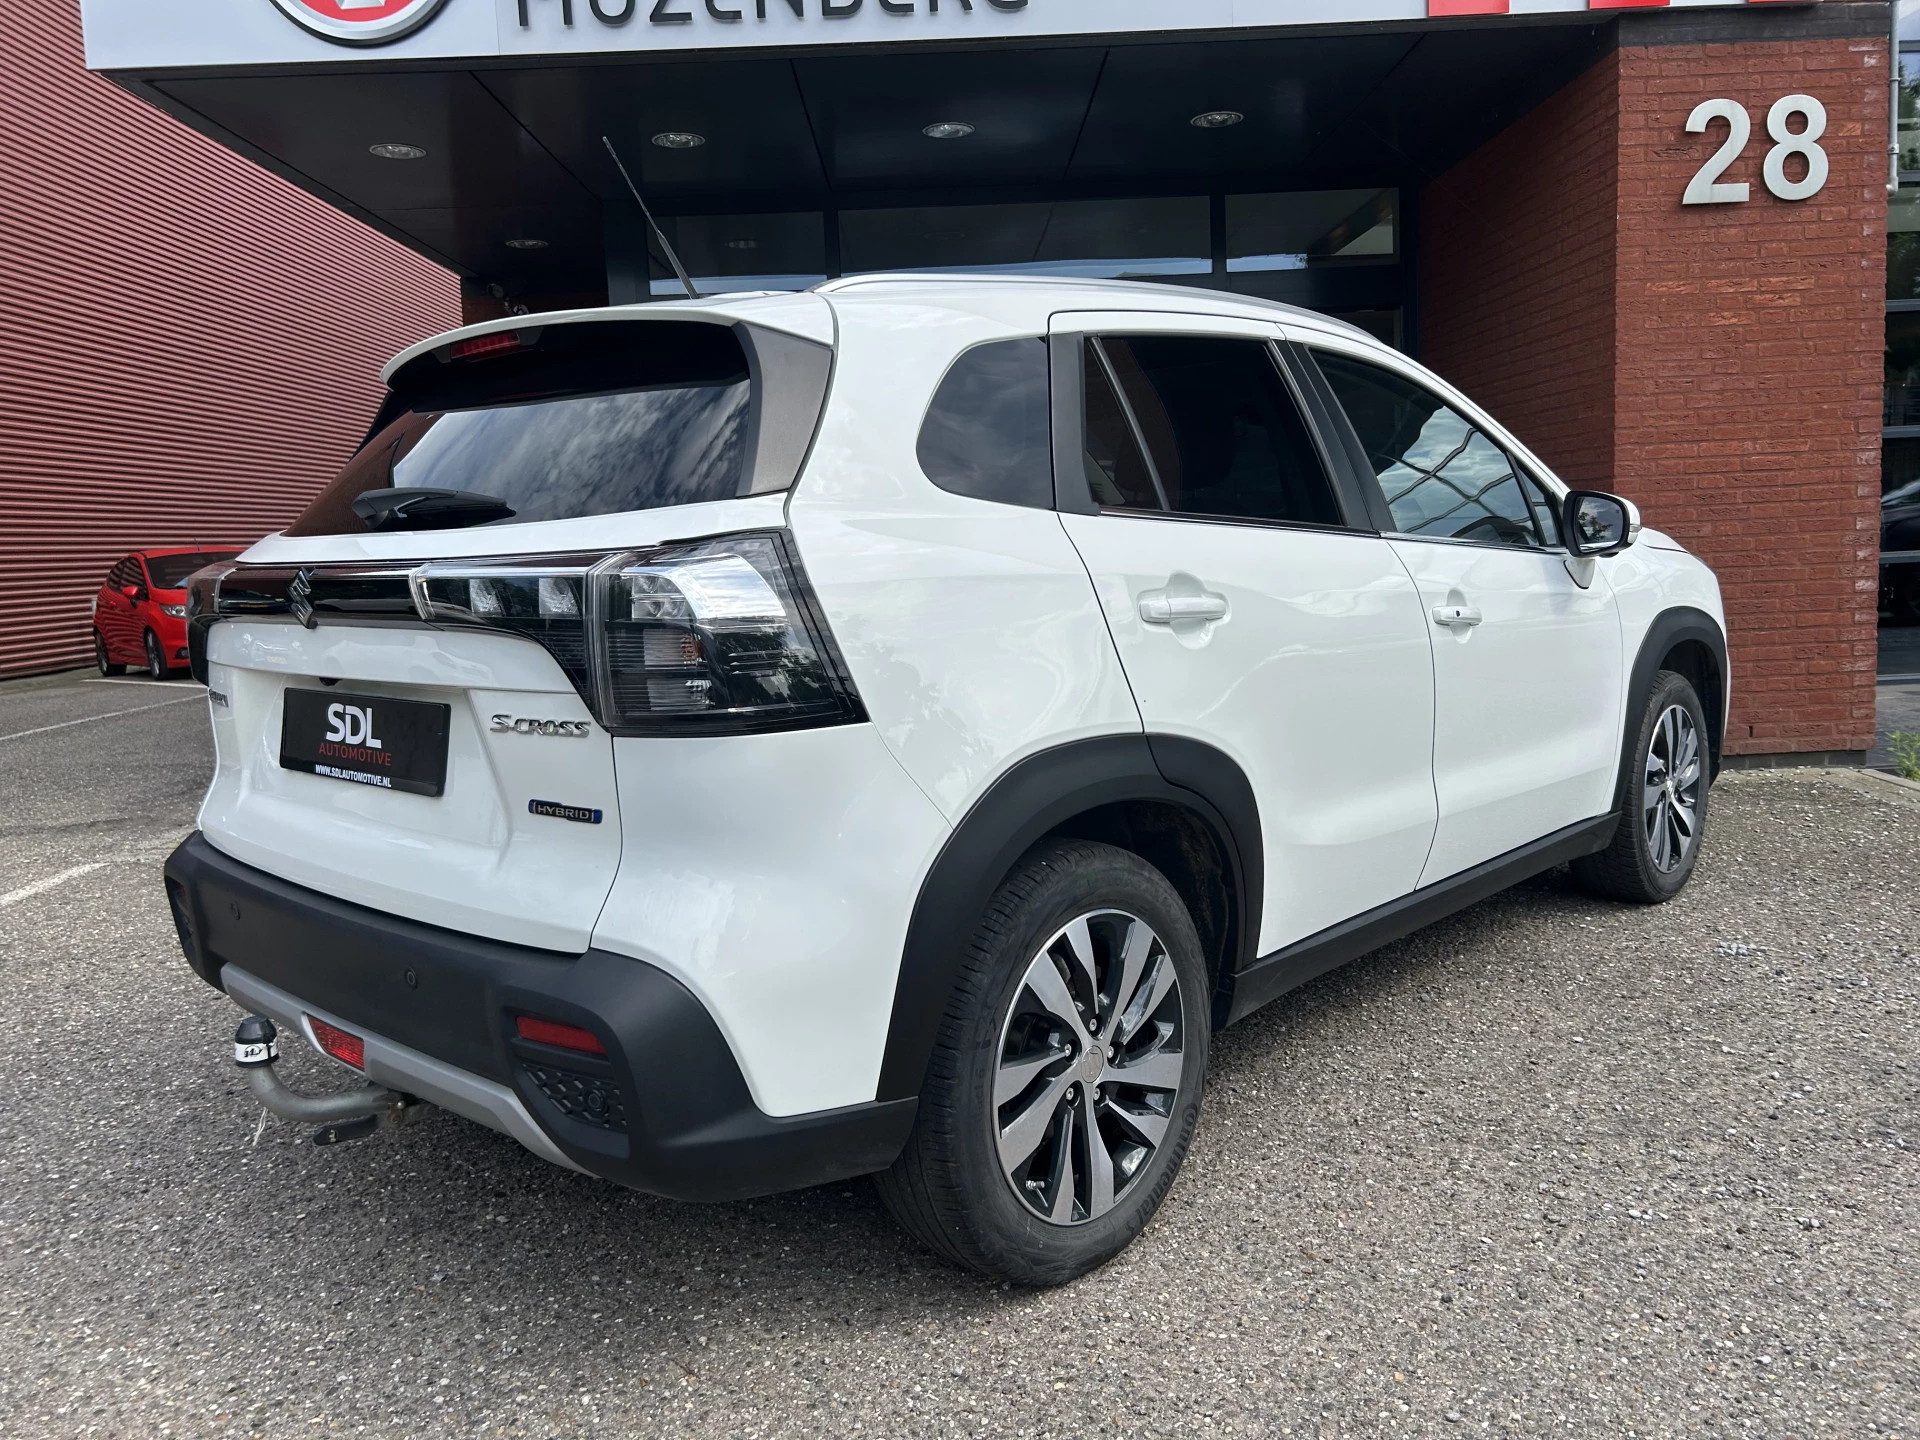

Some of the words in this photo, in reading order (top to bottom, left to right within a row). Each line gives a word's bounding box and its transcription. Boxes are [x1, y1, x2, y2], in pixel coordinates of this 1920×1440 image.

[1682, 94, 1829, 205] 28
[325, 703, 382, 749] SDL
[490, 714, 591, 738] S-CROSS
[318, 742, 392, 767] AUTOMOTIVE
[315, 764, 392, 788] WWW.SDLAUTOMOTIVE.NL
[537, 805, 590, 820] HYBRID
